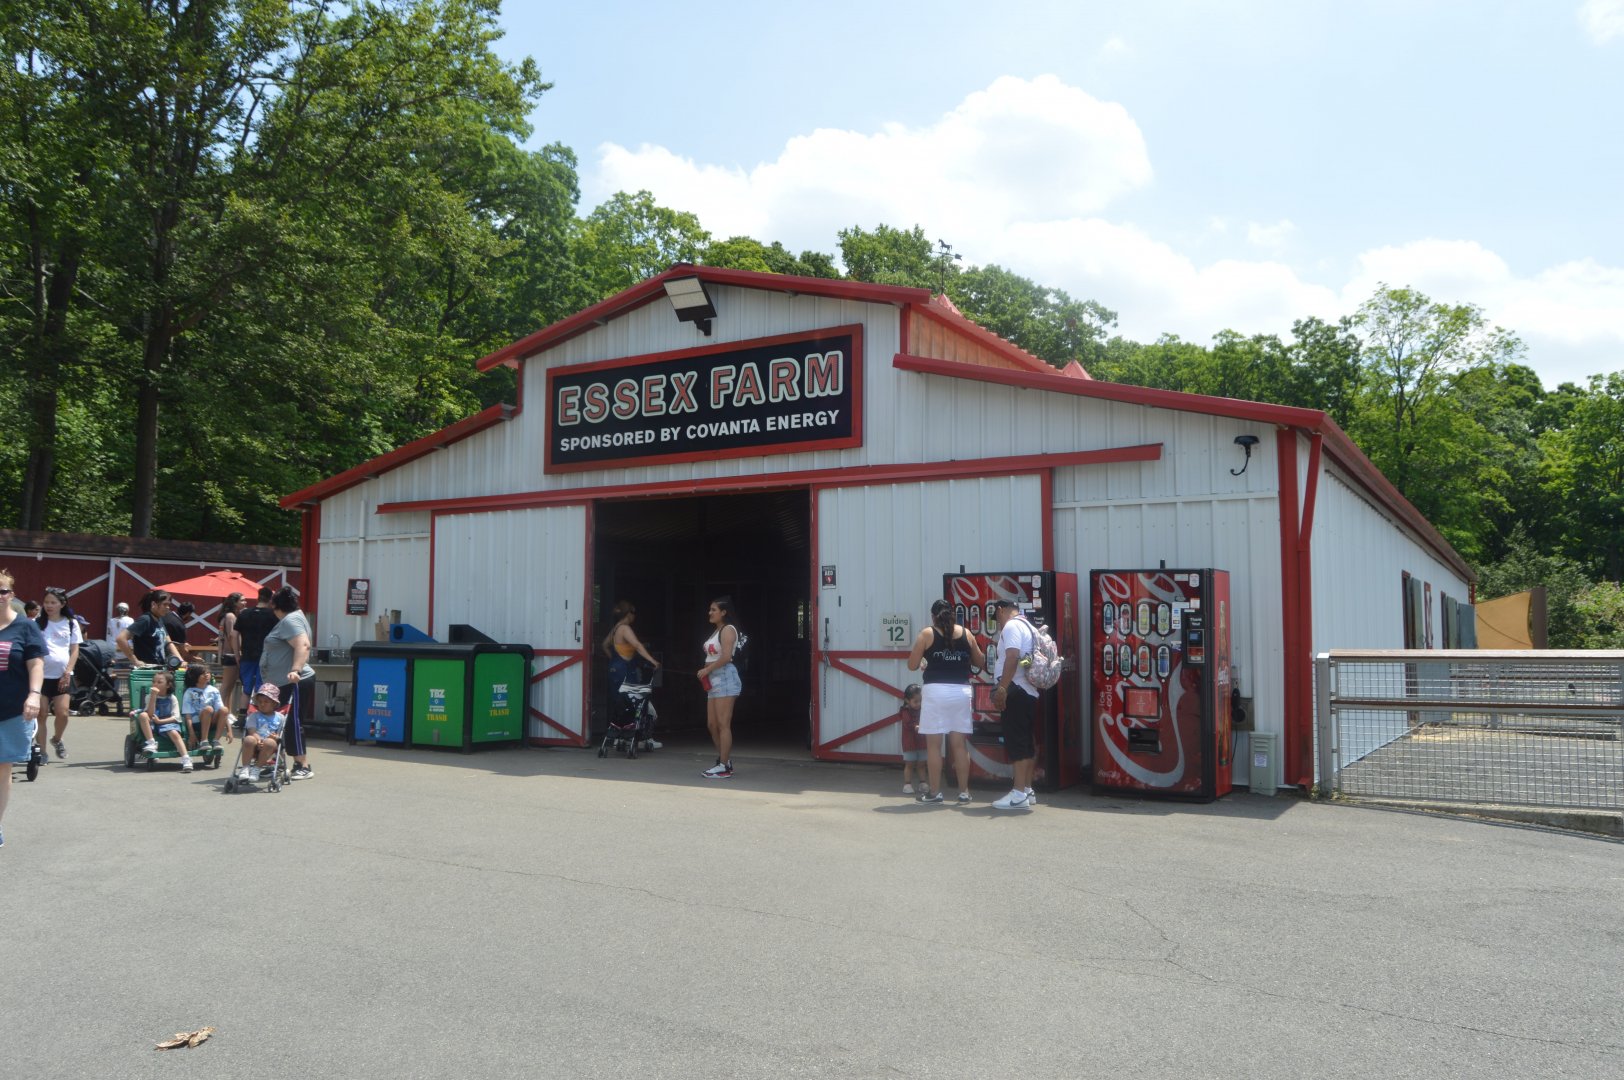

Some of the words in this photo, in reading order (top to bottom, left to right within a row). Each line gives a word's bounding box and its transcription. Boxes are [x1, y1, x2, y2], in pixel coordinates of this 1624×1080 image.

[558, 371, 698, 426] ESSEX
[711, 350, 843, 409] FARM
[560, 430, 655, 451] SPONSORED
[660, 427, 681, 442] BY
[686, 419, 760, 439] COVANTA
[766, 410, 839, 431] ENERGY
[882, 618, 909, 626] Building
[887, 626, 904, 641] 12
[373, 684, 388, 694] TBZ
[430, 688, 446, 698] TBZ
[492, 684, 508, 693] TBZ
[426, 713, 448, 721] TRASH
[489, 708, 510, 717] TRASH
